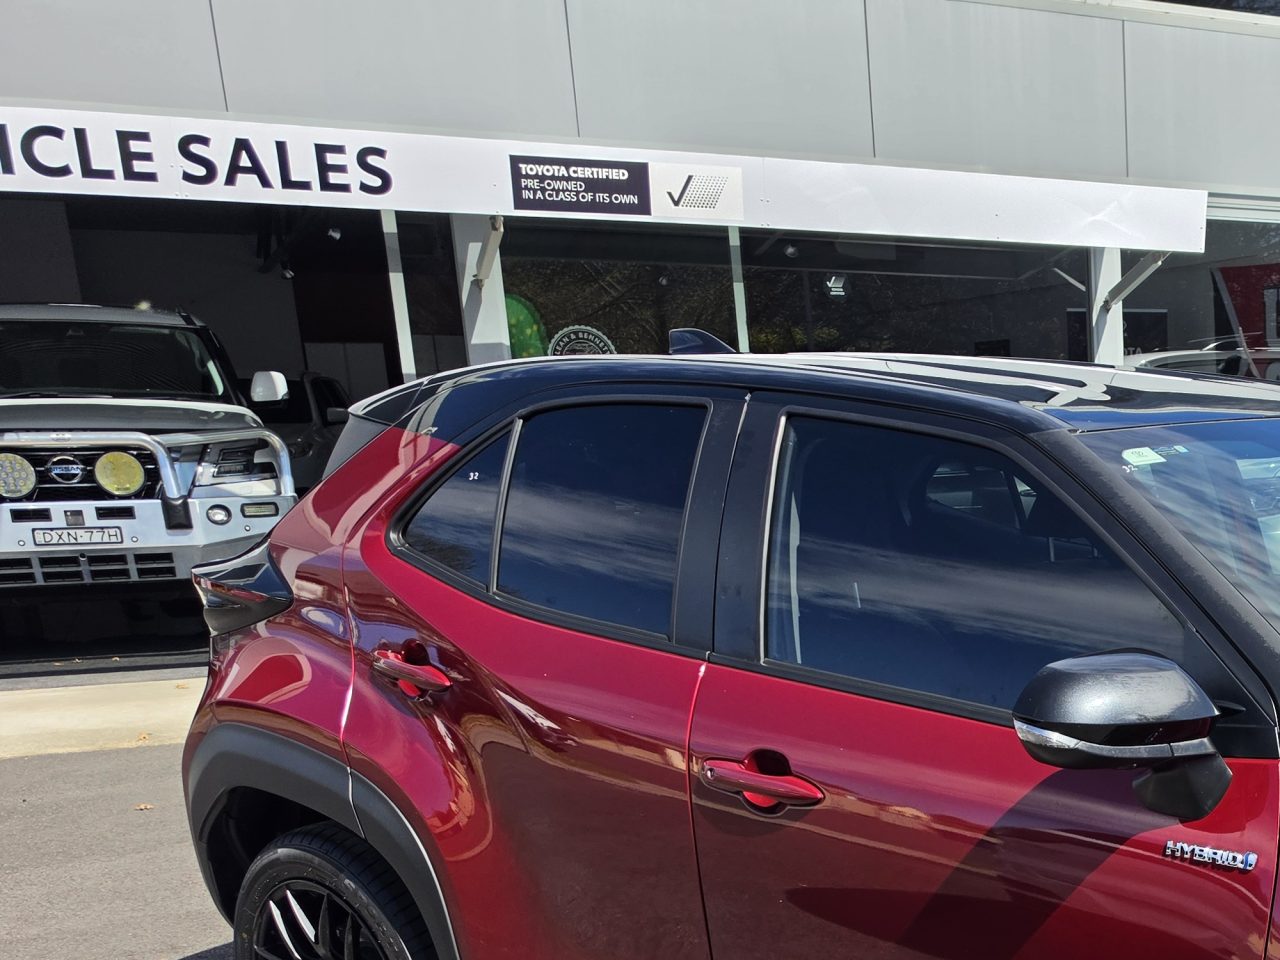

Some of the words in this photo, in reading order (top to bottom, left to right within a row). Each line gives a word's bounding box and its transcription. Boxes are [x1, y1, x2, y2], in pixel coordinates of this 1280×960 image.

[178, 134, 393, 196] SALES
[518, 163, 568, 177] TOYOTA
[569, 166, 629, 180] CERTIFIED
[521, 179, 585, 191] PRE-OWNED
[522, 190, 534, 199] IN
[535, 191, 544, 200] A
[545, 191, 577, 202] CLASS
[579, 193, 593, 202] OF
[596, 194, 609, 203] ITS
[611, 194, 638, 204] OWN
[48, 465, 82, 473] NISSAN
[1166, 840, 1245, 868] HYBRID
